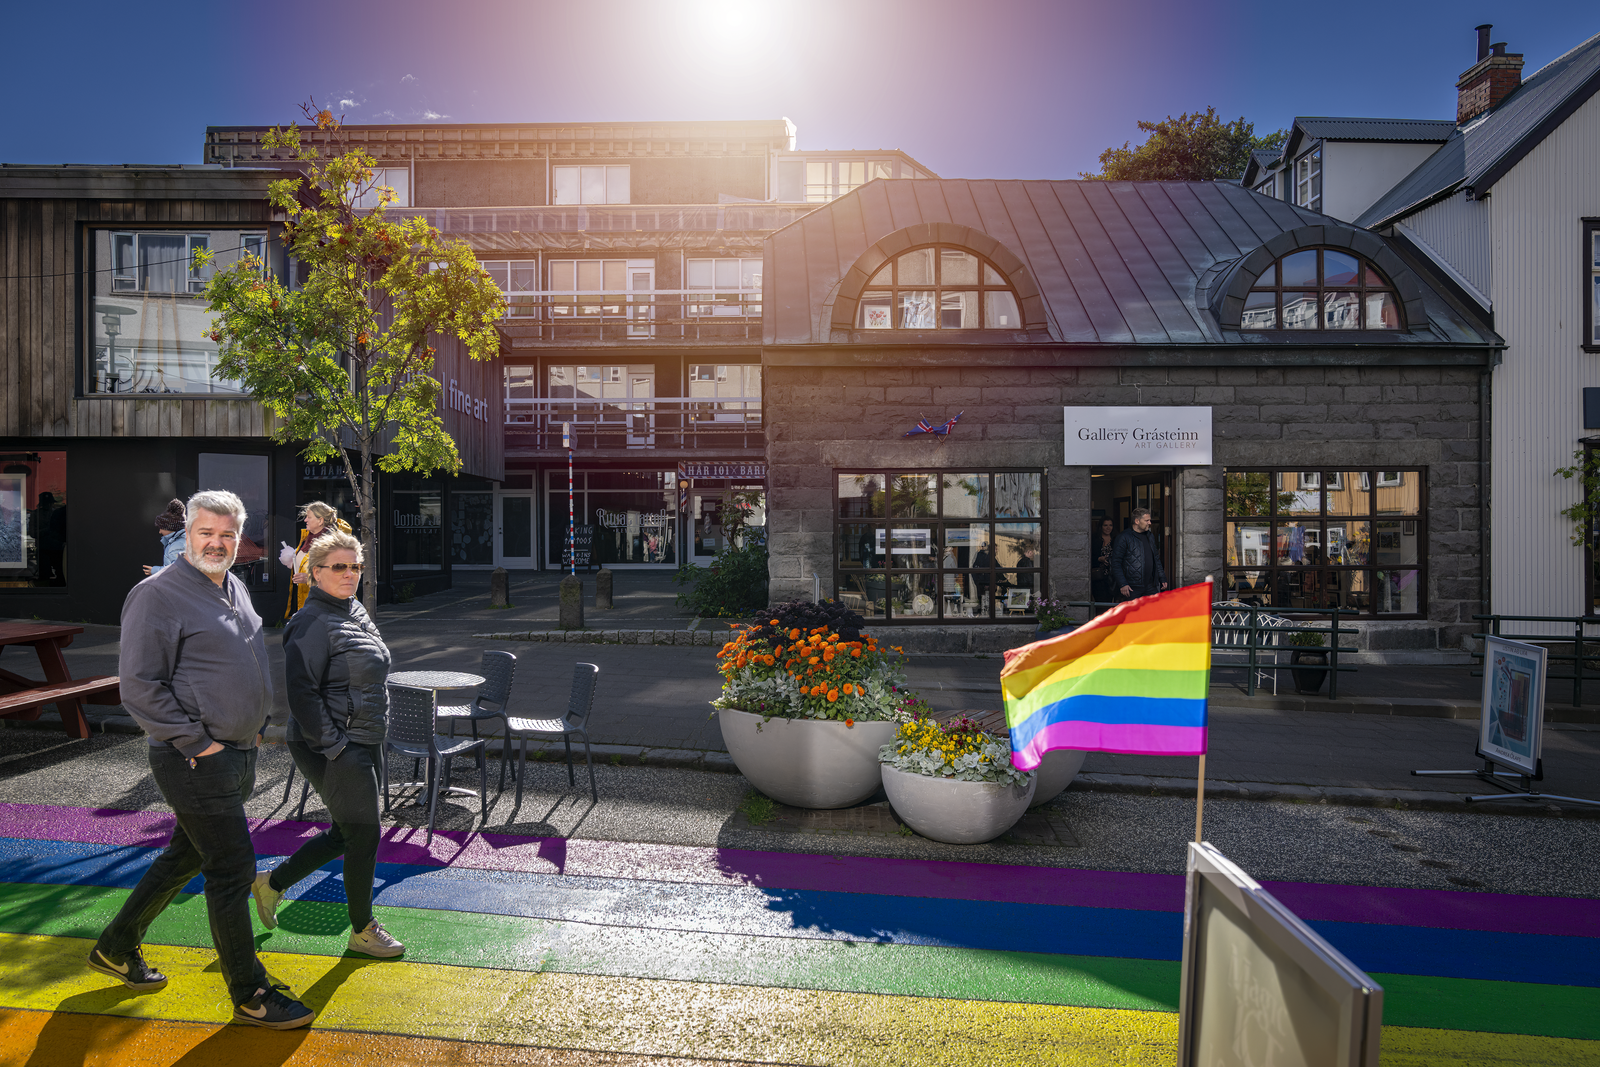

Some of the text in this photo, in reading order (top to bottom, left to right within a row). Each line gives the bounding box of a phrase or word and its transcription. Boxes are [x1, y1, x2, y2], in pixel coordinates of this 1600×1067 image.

[449, 379, 488, 423] fine art
[1078, 427, 1199, 445] Gallery Grásteinn
[688, 464, 710, 476] HÁR
[714, 465, 729, 476] 101
[565, 526, 593, 535] VKING
